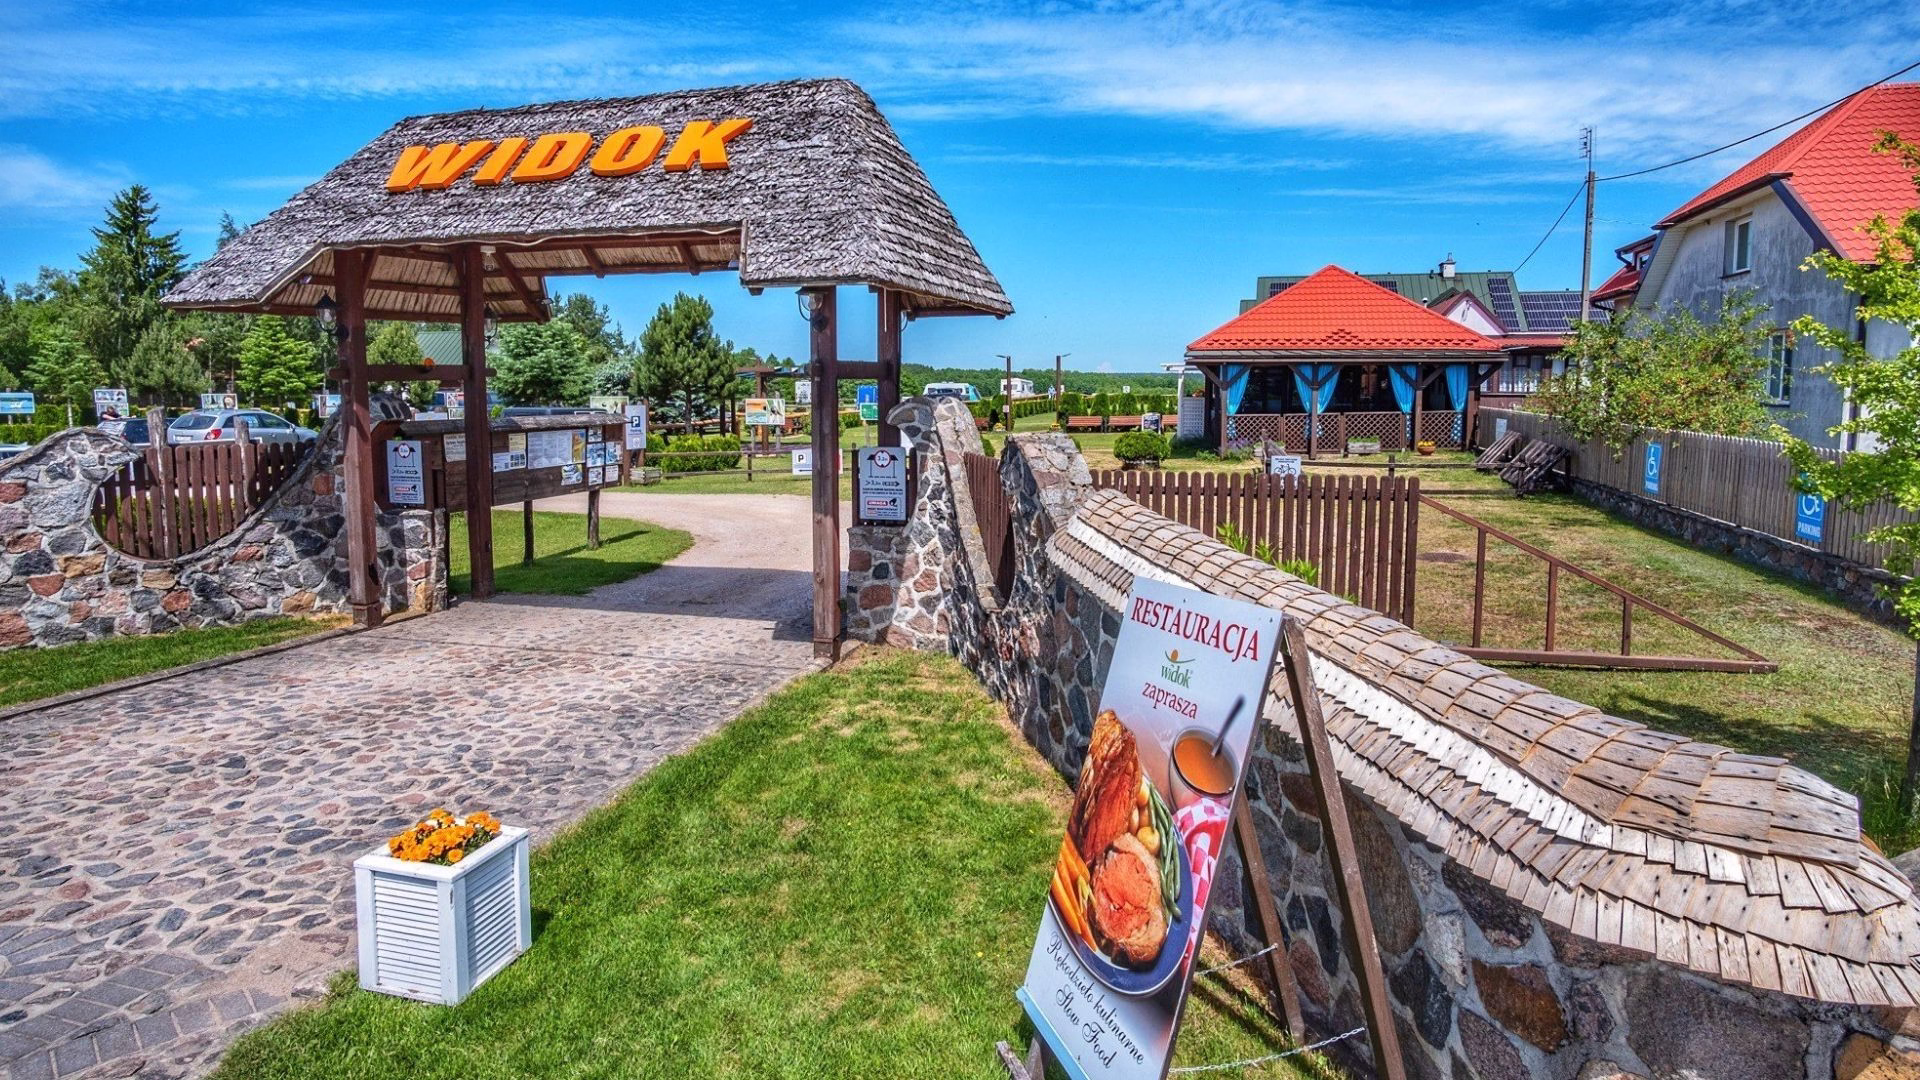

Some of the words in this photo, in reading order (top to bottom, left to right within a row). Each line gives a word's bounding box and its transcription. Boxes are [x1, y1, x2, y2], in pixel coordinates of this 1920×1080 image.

[386, 117, 753, 193] WIDOK
[632, 417, 639, 427] P
[798, 454, 804, 463] P
[1131, 597, 1259, 662] RESTAURACJA
[1142, 682, 1198, 719] zaprasza
[1161, 664, 1192, 689] widok
[1056, 984, 1080, 1026] Slow
[1082, 1022, 1117, 1069] Food
[1093, 994, 1144, 1065] kulinarne
